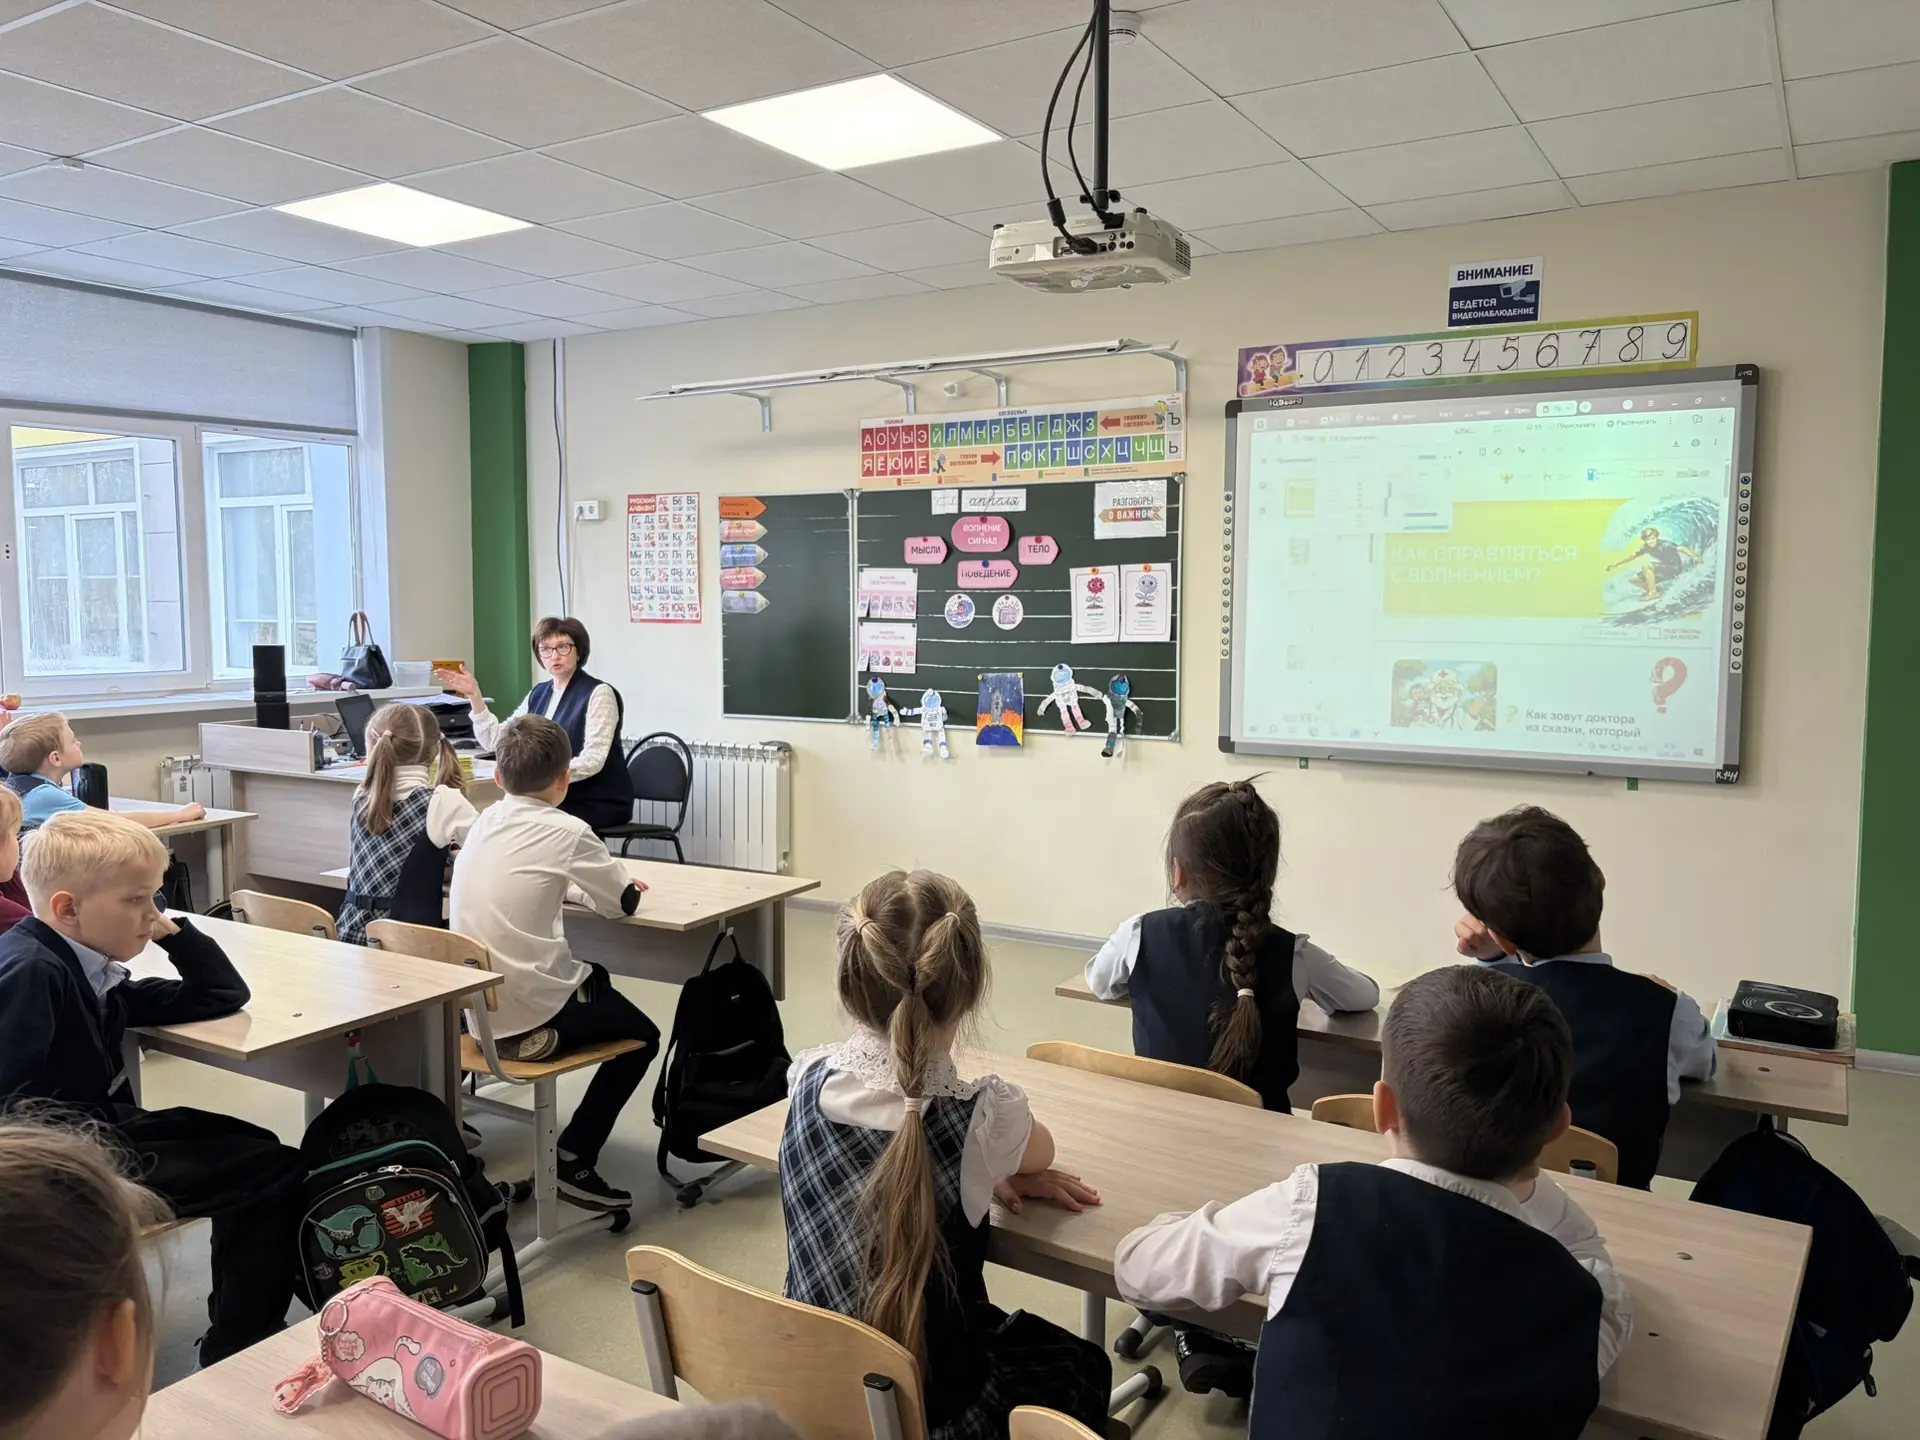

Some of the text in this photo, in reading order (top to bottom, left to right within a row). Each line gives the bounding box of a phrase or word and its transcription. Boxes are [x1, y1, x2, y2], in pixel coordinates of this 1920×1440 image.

[1457, 264, 1533, 281] ВНИМАНИЕ!
[1452, 298, 1497, 310] ВЕДЕТСЯ
[1452, 307, 1535, 320] ВИДЕОНАБЛЮДЕНИЕ
[1313, 322, 1687, 383] 0 1 2 3 4 5 6 7 8 9
[1269, 398, 1304, 408] IQBoard
[1168, 412, 1180, 426] Ъ
[864, 418, 1095, 446] А О У Ы Э Й Л М Н Р Б В Г Д Ж З
[1006, 438, 1178, 464] П Ф К Т Ш С Х Ц Ч Щ Ь
[864, 455, 927, 472] Я Ё Ю И Е
[1112, 497, 1154, 507] РАЗГОВОРЫ
[1117, 509, 1153, 519] ВАЖНОМ
[963, 524, 1002, 532] ВОЛНЕНИЕ
[967, 537, 998, 545] СИГНАЛ
[910, 545, 941, 555] МЫСЛИ
[1028, 544, 1050, 554] ТЕЛО
[1392, 545, 1578, 563] КАК СПРАВЛЯТЬСЯ
[961, 568, 1011, 579] ПОВЕДЕНИЕ
[1392, 567, 1541, 584] С ВОЛНЕНИЕМ?
[1526, 709, 1635, 727] Как зовут доктора
[1525, 724, 1641, 739] из сказки, который
